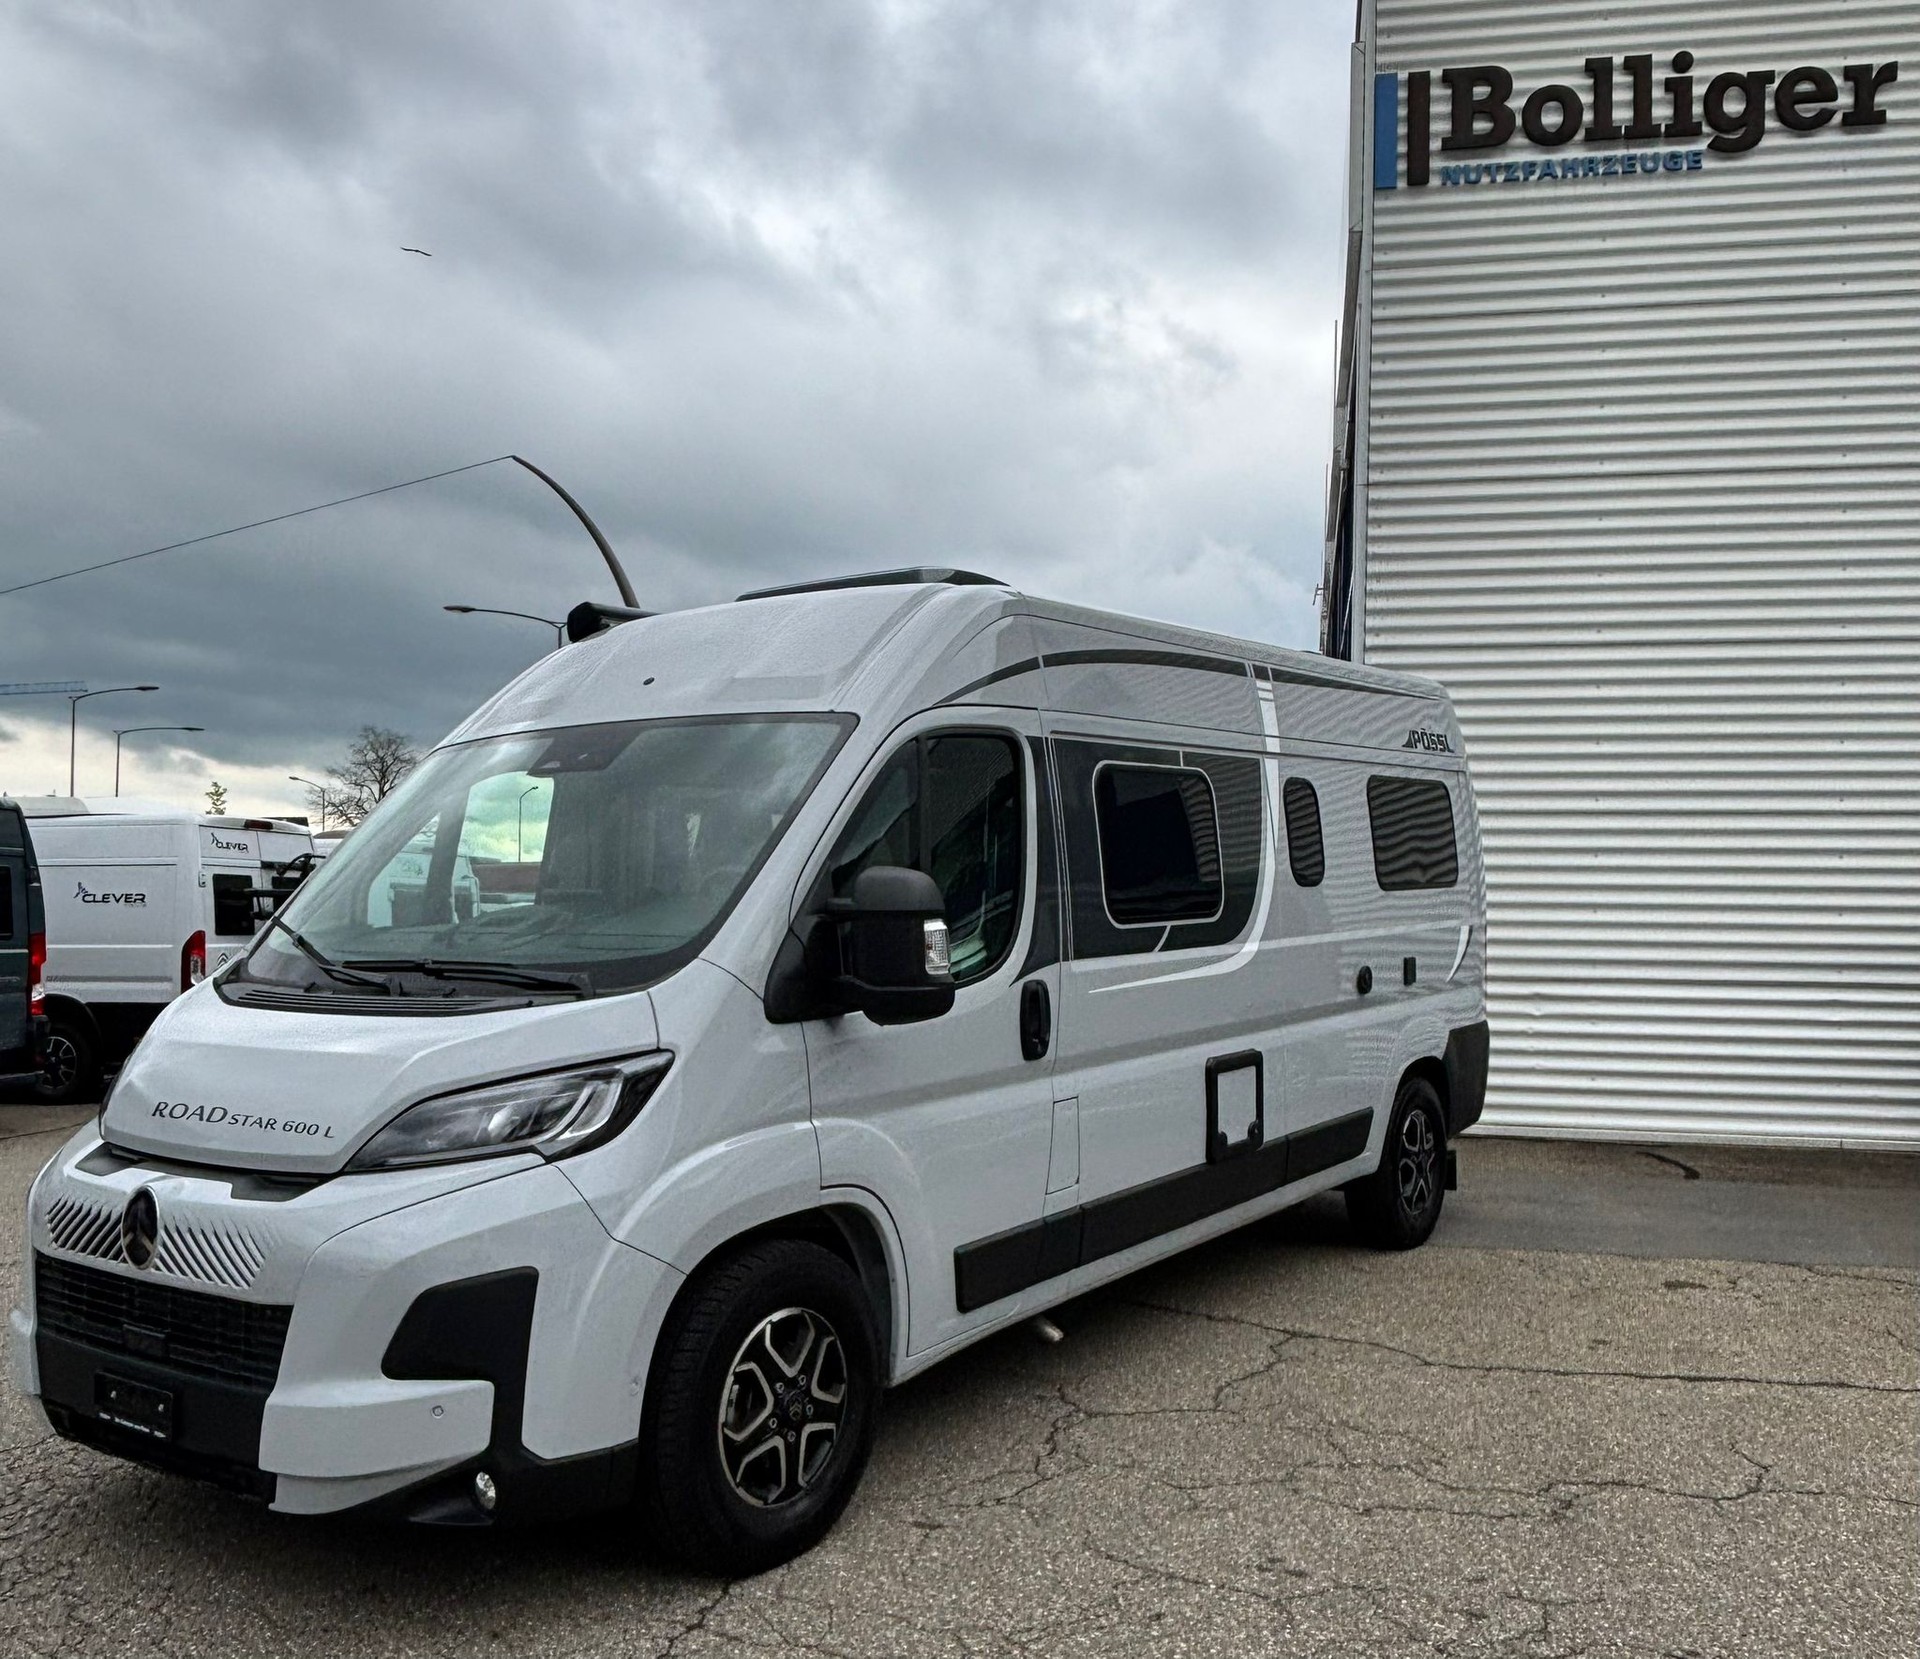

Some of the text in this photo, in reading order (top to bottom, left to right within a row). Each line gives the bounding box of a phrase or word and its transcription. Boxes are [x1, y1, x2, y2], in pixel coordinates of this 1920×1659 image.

[1441, 50, 1898, 152] Bolliger
[1440, 149, 1703, 186] NUTZFAHRZEUGE
[82, 893, 146, 903] CLEVER
[282, 1121, 319, 1136] 600
[323, 1126, 335, 1139] L
